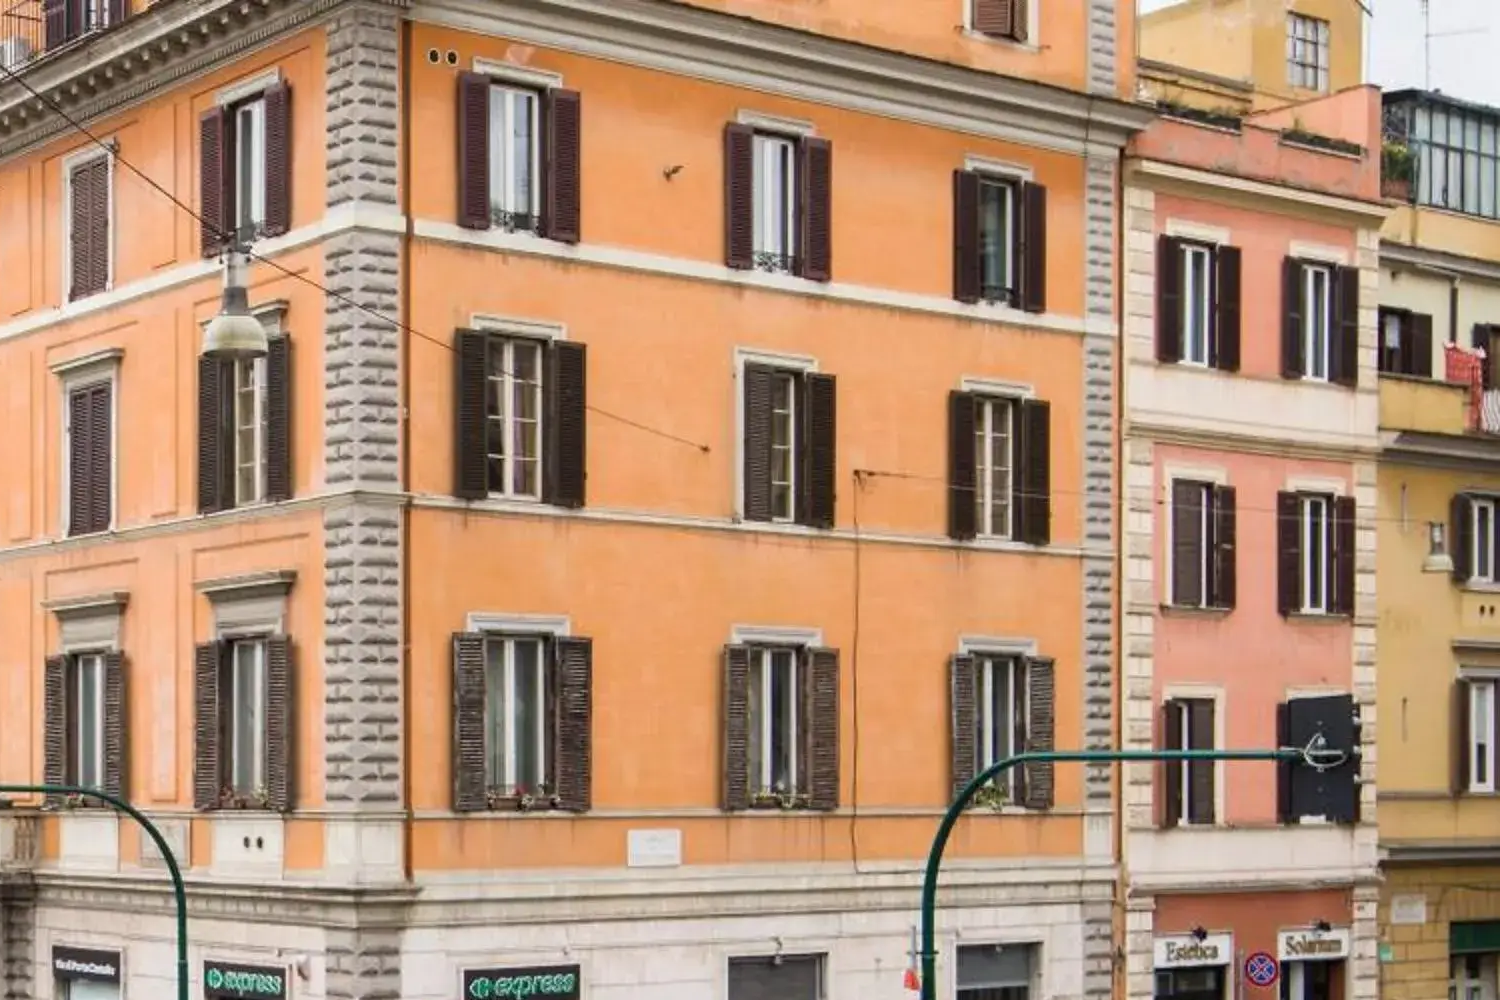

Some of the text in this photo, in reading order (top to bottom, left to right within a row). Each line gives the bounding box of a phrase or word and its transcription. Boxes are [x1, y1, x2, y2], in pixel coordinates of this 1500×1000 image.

[1165, 941, 1218, 962] Estetica
[1285, 934, 1342, 956] Solarium
[224, 971, 282, 997] express
[495, 974, 575, 1000] express
